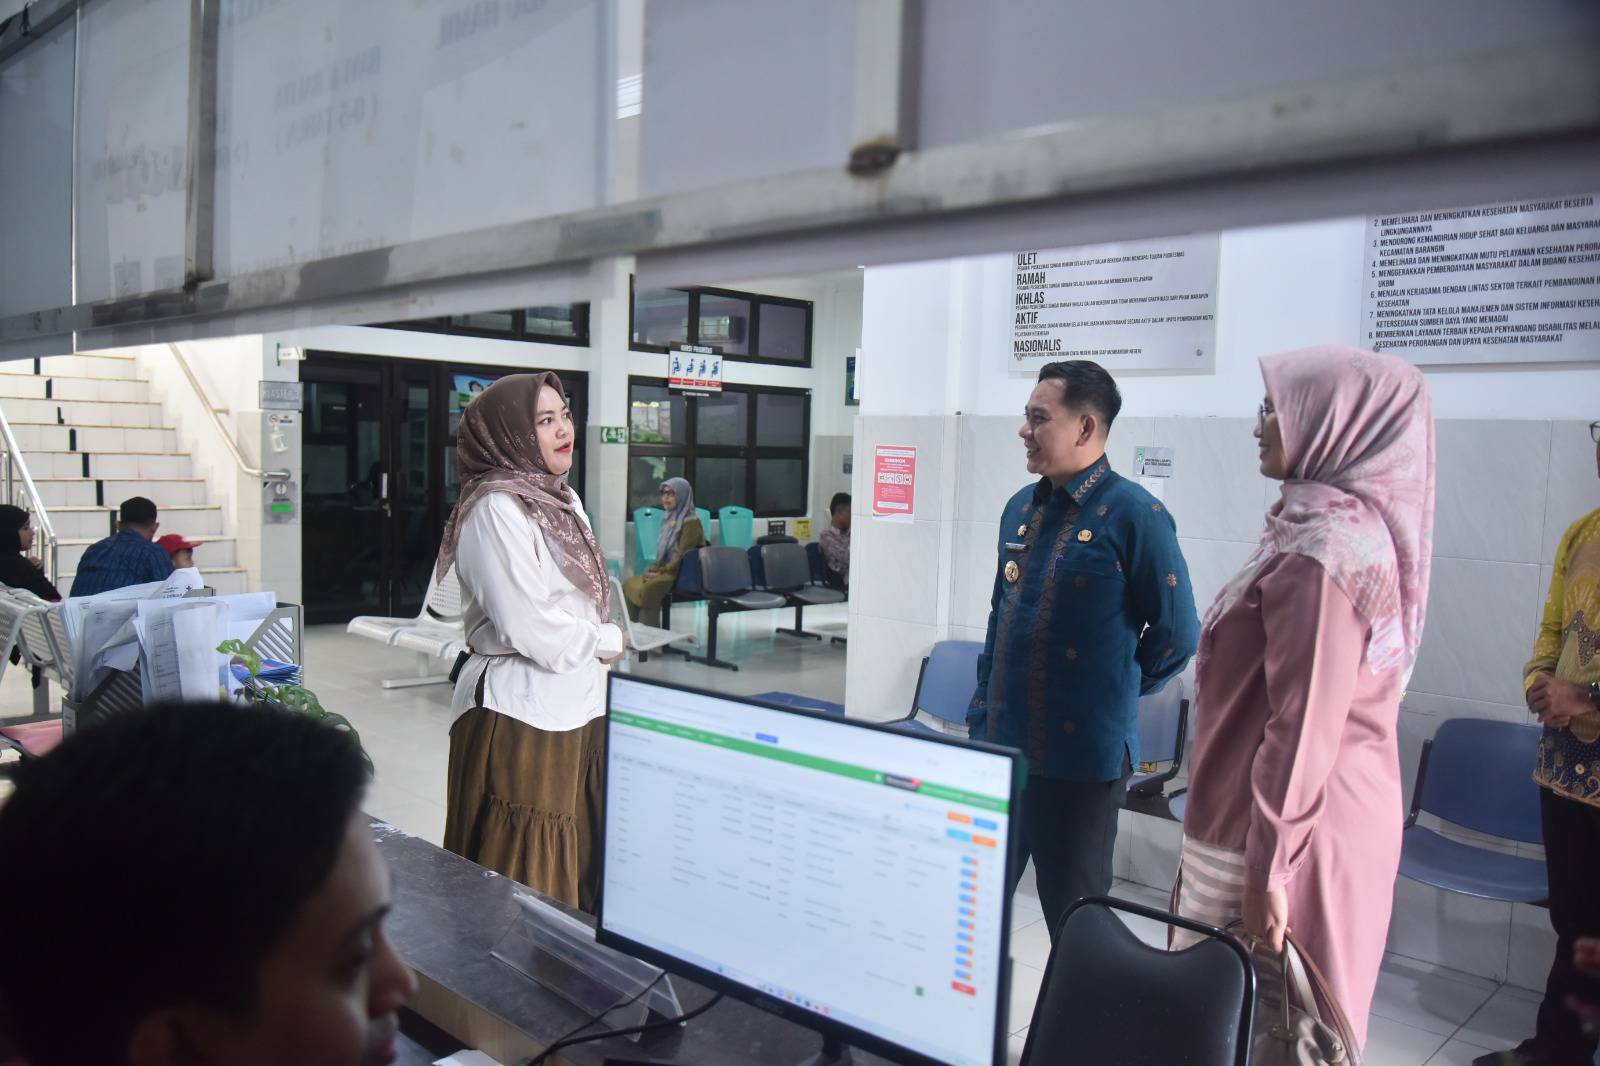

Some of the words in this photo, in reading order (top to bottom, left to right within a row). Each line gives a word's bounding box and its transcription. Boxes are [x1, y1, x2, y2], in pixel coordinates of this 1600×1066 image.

[1381, 215, 1419, 226] MEMELIHARA
[1420, 214, 1432, 223] DAN
[1434, 209, 1480, 221] MENINGKATKAN
[1482, 205, 1518, 217] KESEHATAN
[1520, 200, 1562, 213] MASYARAKAT
[1564, 197, 1594, 209] BESERTA
[1380, 236, 1416, 247] MENDORONG
[1416, 232, 1458, 244] KEMANDIRIAN
[1459, 231, 1478, 240] HIDUP
[1479, 228, 1498, 239] SEHAT
[1500, 227, 1515, 237] BAGI
[1516, 224, 1550, 235] KELUARGA
[1551, 223, 1565, 232] DAN
[1379, 257, 1417, 268] MEMELIHARA
[1418, 256, 1430, 265] DAN
[1431, 252, 1479, 264] MENINGKATKAN
[1480, 251, 1498, 260] MUTU
[1498, 247, 1536, 258] PELAYANAN
[1536, 244, 1574, 255] KESEHATAN
[1380, 247, 1414, 257] KECAMATAN
[1415, 244, 1445, 254] BARANGIN
[1017, 252, 1038, 266] ULET
[1378, 266, 1426, 278] MENGGERAKKAN
[1426, 264, 1474, 275] PEMBERDAYAAN
[1475, 260, 1517, 272] MASYARAKAT
[1518, 258, 1541, 268] DALAM
[1542, 256, 1566, 266] BIDANG
[1016, 272, 1046, 285] RAMAH
[1377, 288, 1406, 298] MENJALIN
[1406, 286, 1441, 296] KERJASAMA
[1442, 285, 1467, 294] DENGAN
[1468, 283, 1489, 293] LINTAS
[1490, 281, 1515, 292] SEKTOR
[1516, 280, 1543, 290] TERKAIT
[1543, 276, 1595, 288] PEMBANGUNAN
[1016, 292, 1044, 305] IKHLAS
[1377, 299, 1410, 308] KESEHATAN
[1376, 308, 1421, 318] MENINGKATKAN
[1423, 308, 1436, 316] TATA
[1437, 306, 1460, 315] KELOLA
[1461, 304, 1499, 314] MANAJEMEN
[1500, 303, 1514, 312] DAN
[1515, 302, 1539, 312] SISTEM
[1540, 300, 1576, 310] INFORMASI
[1577, 298, 1600, 308] KESEH
[1016, 312, 1038, 324] AKTIF
[1376, 320, 1419, 328] KETERSEDIAAN
[1419, 318, 1444, 327] SUMBER
[1445, 316, 1461, 325] DAYA
[1462, 315, 1478, 324] YANG
[1479, 314, 1509, 324] MEMADAI
[1376, 329, 1414, 338] MEMBERIKAN
[1415, 328, 1442, 337] LAYANAN
[1442, 327, 1468, 336] TERBAIK
[1469, 325, 1493, 334] KEPADA
[1494, 324, 1537, 334] PENYANDANG
[1538, 322, 1578, 332] DISABILITAS
[1014, 339, 1062, 352] NASIONALIS
[1376, 340, 1408, 349] KESEHATAN
[1408, 338, 1448, 348] PERORANGAN
[1448, 338, 1461, 346] DAN
[1462, 337, 1482, 346] UPAYA
[1483, 336, 1518, 345] KESEHATAN
[1520, 334, 1563, 344] MASYARAKAT
